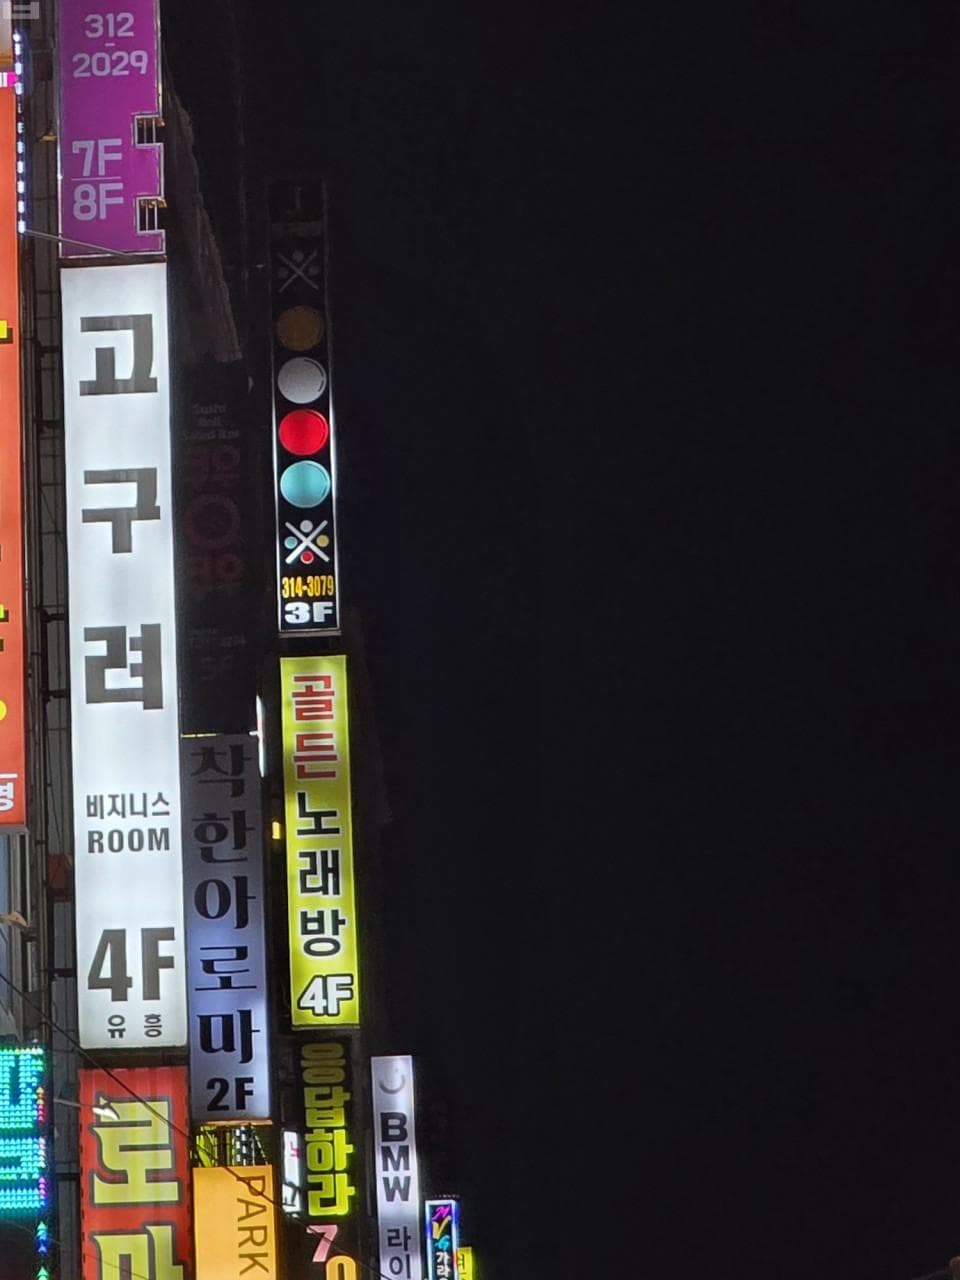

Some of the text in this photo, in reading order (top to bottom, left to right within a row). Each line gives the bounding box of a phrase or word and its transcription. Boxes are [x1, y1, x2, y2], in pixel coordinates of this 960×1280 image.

[84, 13, 135, 38] 312
[72, 50, 148, 78] 2029
[72, 138, 123, 176] 7F
[72, 183, 125, 220] 8F
[79, 314, 164, 711] 고구려
[284, 601, 334, 624] 3F
[86, 792, 170, 819] 비지니스
[87, 829, 170, 853] ROOM
[87, 927, 175, 1003] 4F
[297, 974, 354, 1017] 4F
[206, 1077, 255, 1112] 2F
[301, 1042, 357, 1217] 응답하라
[379, 1112, 412, 1203] BMW
[237, 1175, 271, 1276] PARK
[435, 1251, 451, 1280] 가라
